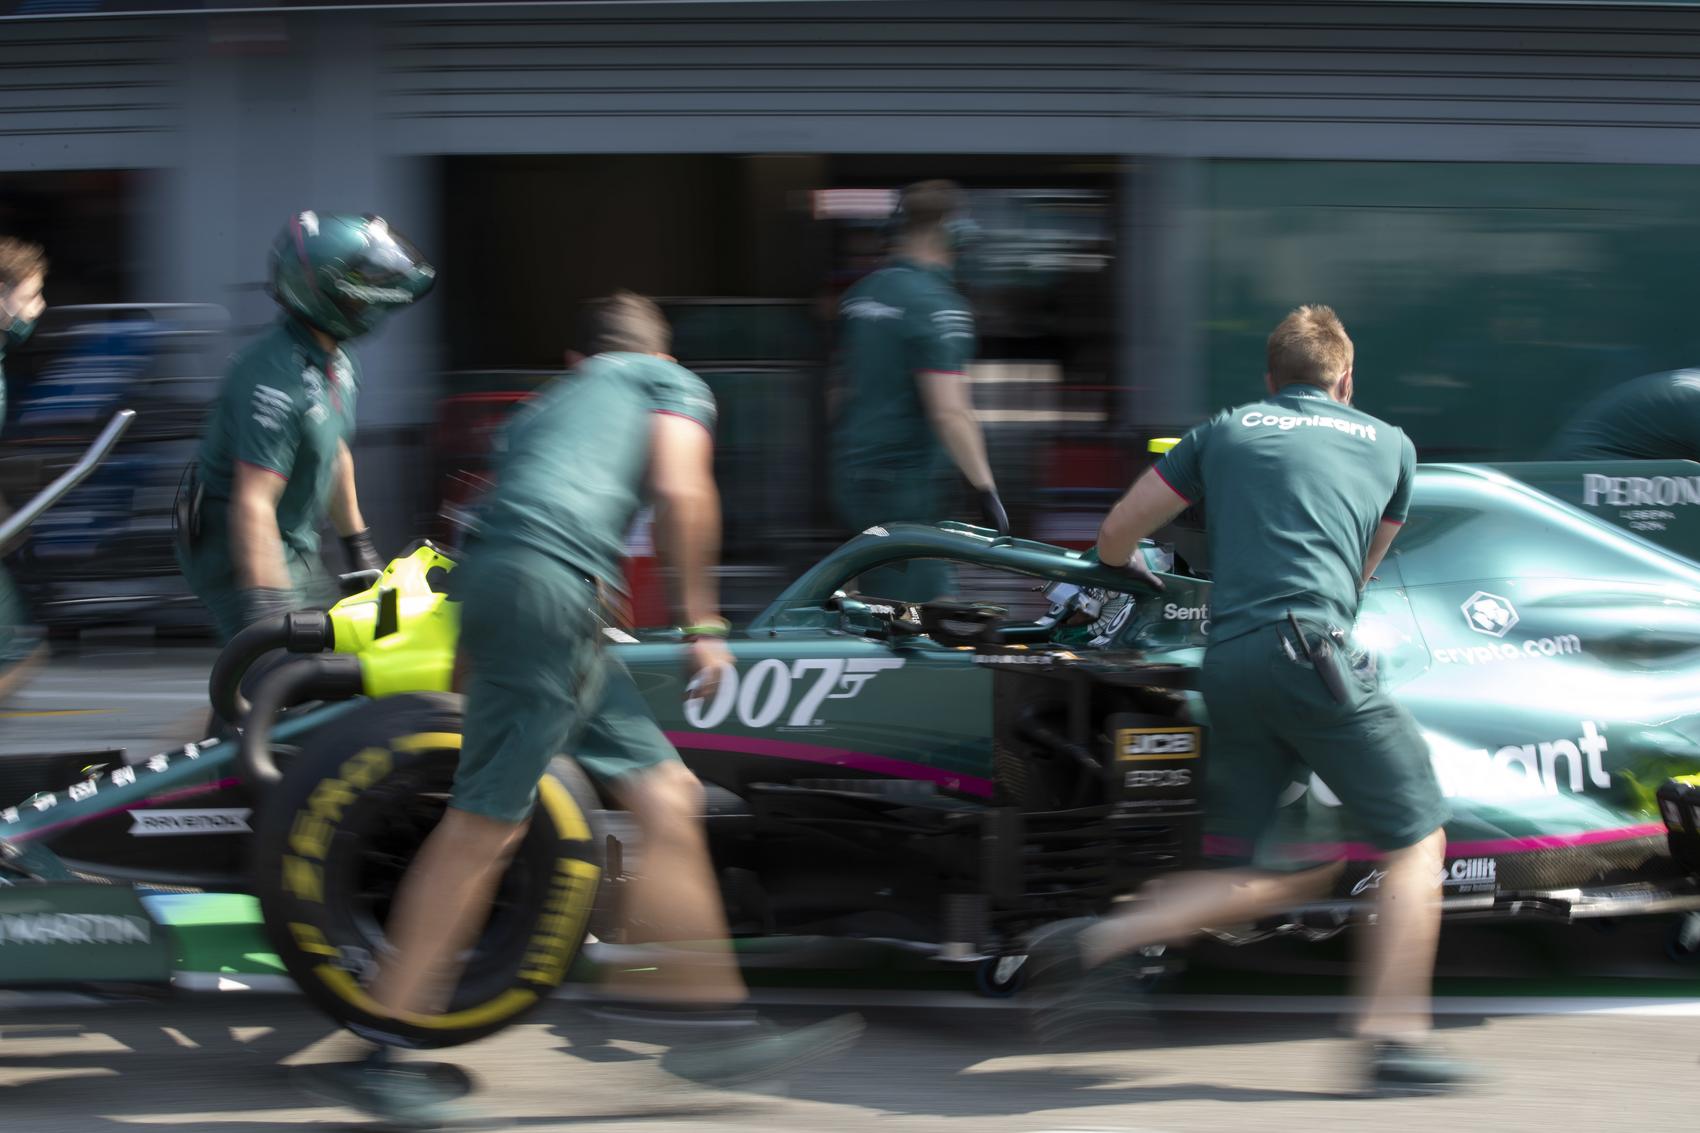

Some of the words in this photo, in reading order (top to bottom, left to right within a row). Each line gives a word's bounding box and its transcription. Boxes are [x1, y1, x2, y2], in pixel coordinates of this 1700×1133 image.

[1241, 411, 1377, 441] Cognizant
[1434, 634, 1582, 665] crypto.com
[683, 658, 845, 729] 007
[1121, 733, 1196, 754] JCB
[1451, 857, 1497, 880] Cillit
